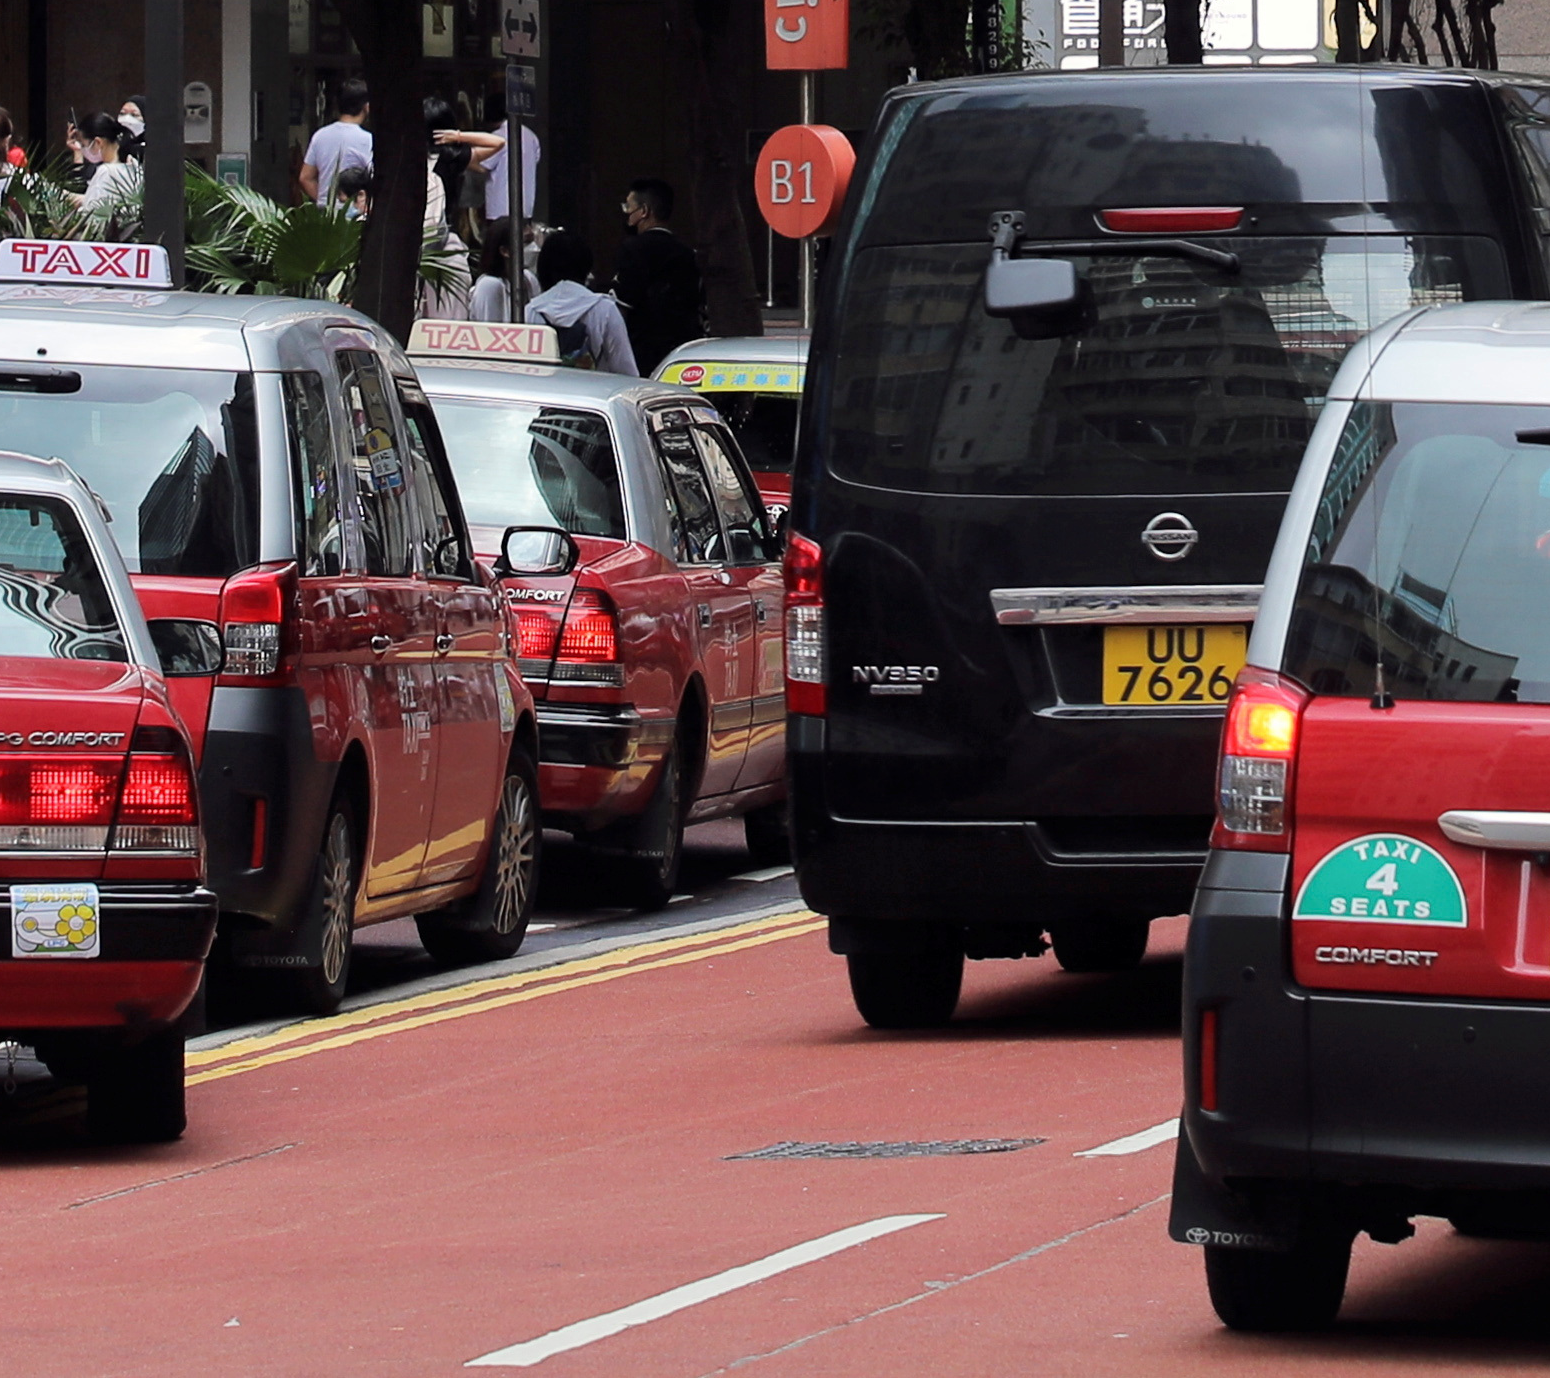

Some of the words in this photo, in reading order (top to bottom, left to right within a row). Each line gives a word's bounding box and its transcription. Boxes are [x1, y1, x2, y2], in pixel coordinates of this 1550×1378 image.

[770, 159, 817, 204] B1
[9, 241, 151, 280] TAXI
[420, 325, 544, 356] TAXI
[508, 588, 565, 601] OMFORT
[1146, 627, 1206, 664] UU
[851, 665, 940, 682] NV350
[1117, 666, 1233, 703] 7626
[28, 732, 126, 746] COMFORT
[1352, 840, 1422, 864] TAXI
[1365, 862, 1399, 896] 4
[1329, 896, 1432, 920] SEATS
[1315, 946, 1439, 966] COMFORT
